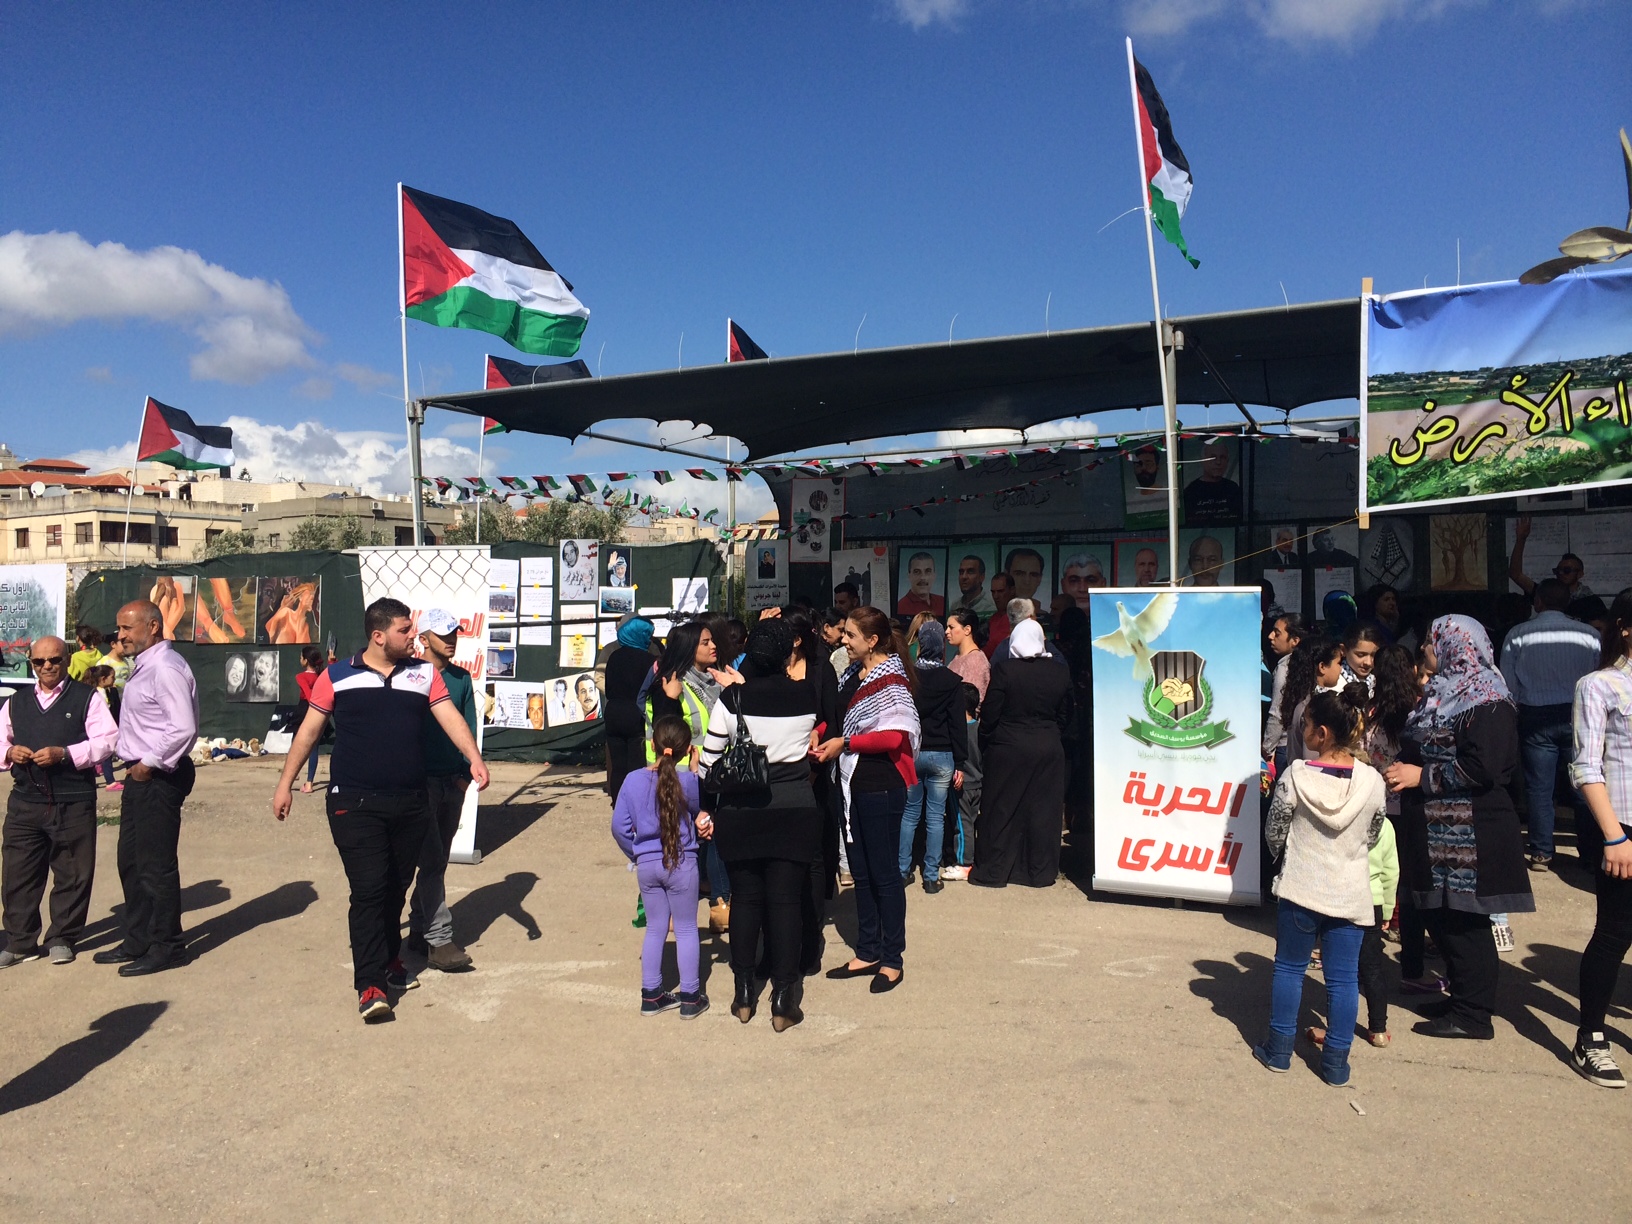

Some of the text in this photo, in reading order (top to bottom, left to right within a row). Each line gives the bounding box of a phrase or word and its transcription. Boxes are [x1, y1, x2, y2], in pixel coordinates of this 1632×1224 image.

[1389, 369, 1575, 466] الأرض
[1186, 732, 1208, 741] مؤسسة
[1123, 771, 1248, 818] الحرية
[1117, 831, 1243, 876] لأسرى
